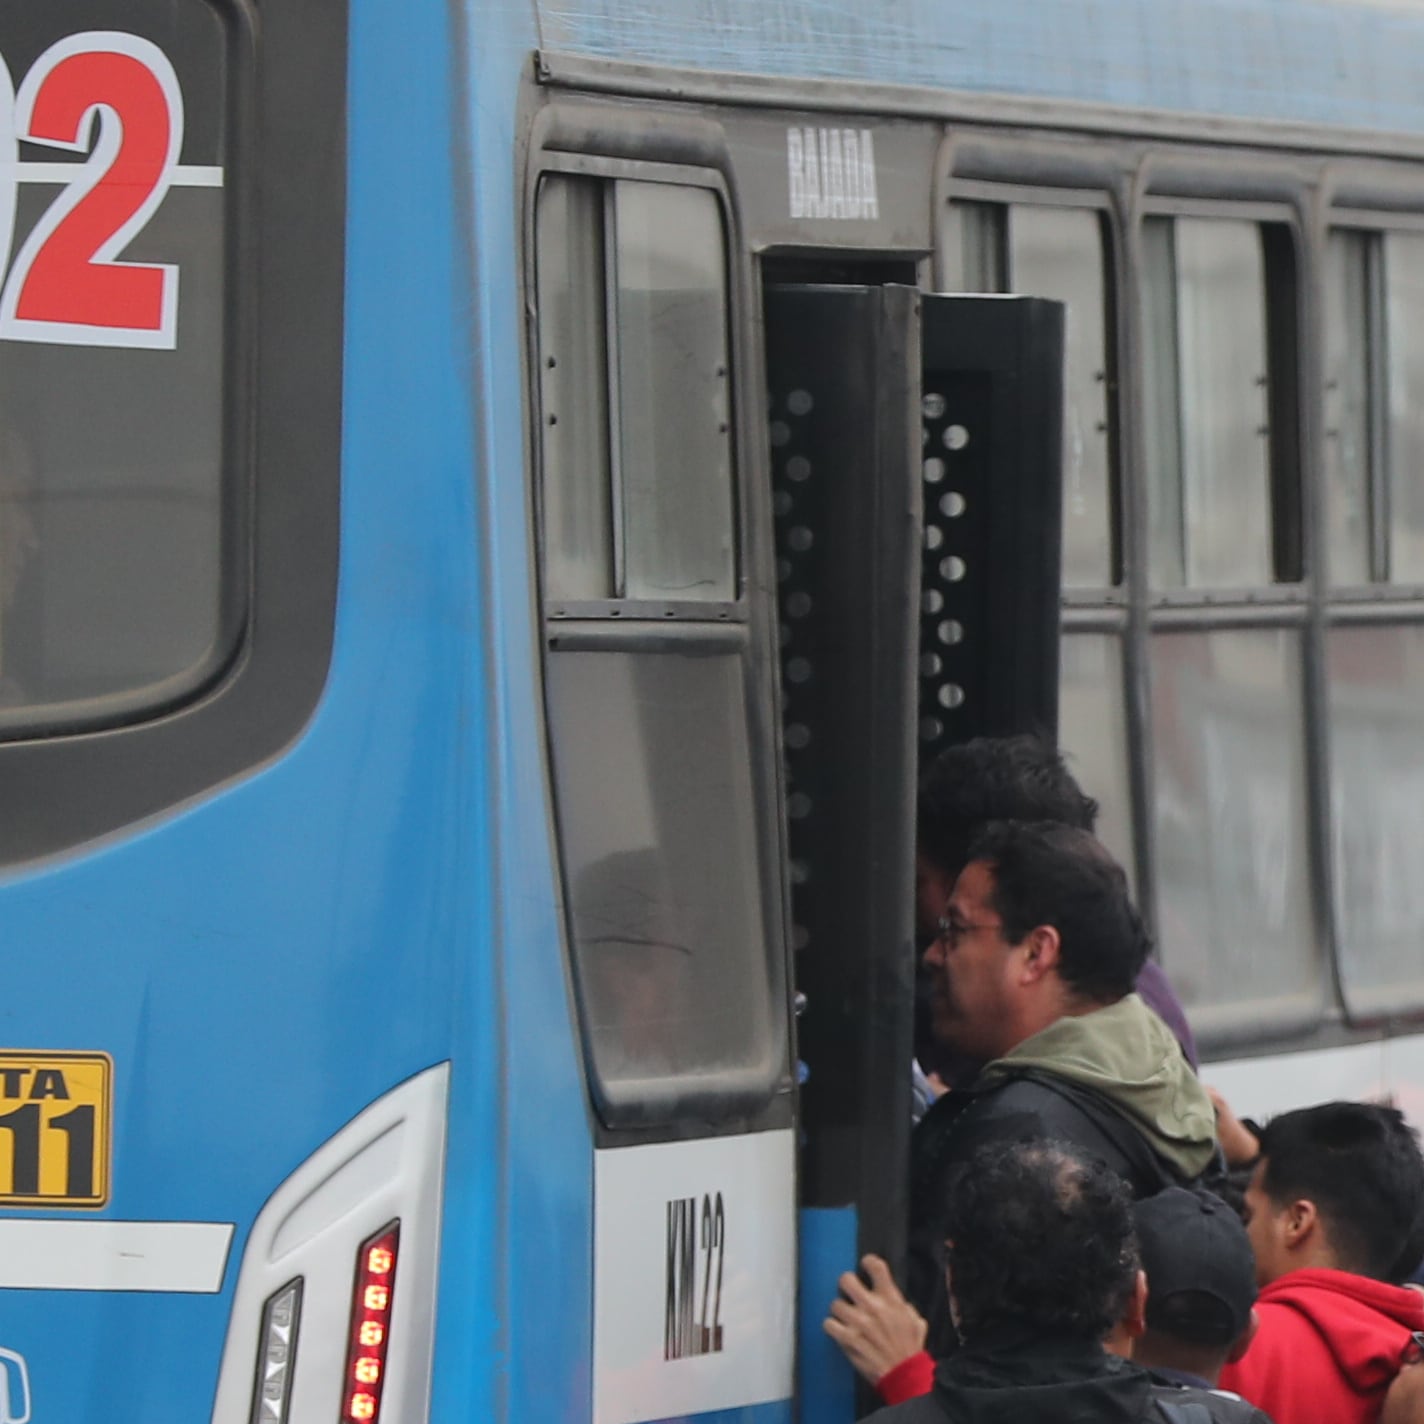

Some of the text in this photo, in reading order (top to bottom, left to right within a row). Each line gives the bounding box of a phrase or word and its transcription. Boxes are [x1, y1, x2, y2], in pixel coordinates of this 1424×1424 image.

[0, 30, 184, 350] 2
[0, 1068, 70, 1100] TA
[0, 1103, 95, 1196] 11
